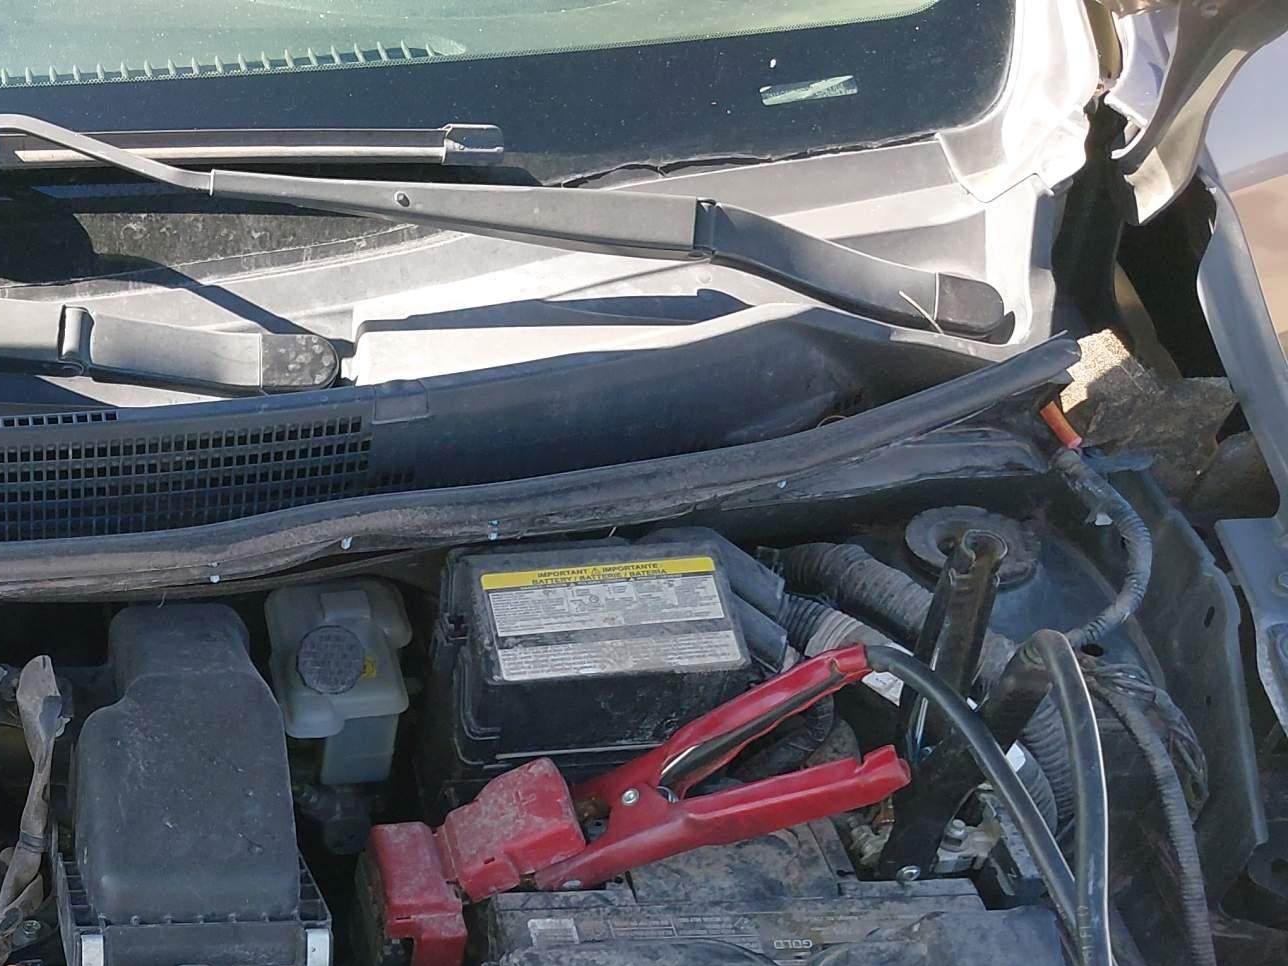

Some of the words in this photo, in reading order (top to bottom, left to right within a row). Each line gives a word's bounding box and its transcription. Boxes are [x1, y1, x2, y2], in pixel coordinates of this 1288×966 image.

[537, 569, 588, 578] IMPORTANT
[602, 562, 659, 573] IMPORTANTE
[531, 576, 572, 584] BATTERY
[578, 572, 622, 582] BATTERIE
[773, 939, 813, 950] GOLD
